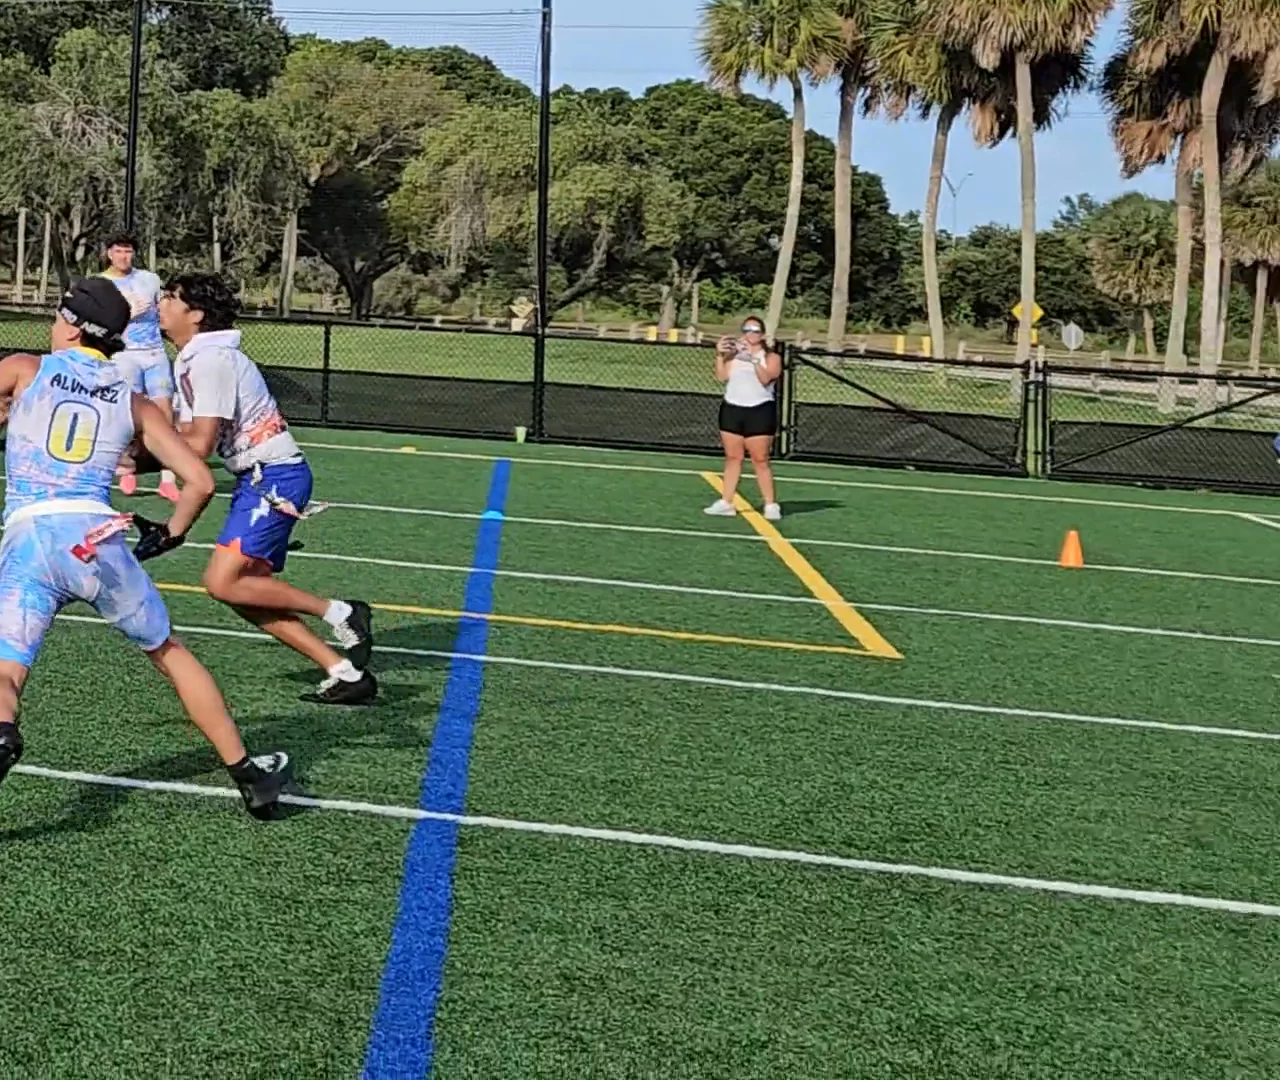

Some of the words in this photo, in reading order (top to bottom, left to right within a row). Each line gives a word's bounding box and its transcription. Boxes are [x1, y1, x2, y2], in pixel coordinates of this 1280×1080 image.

[80, 321, 109, 338] NIKE
[49, 372, 120, 405] ALVAREZ
[46, 400, 101, 464] 0
